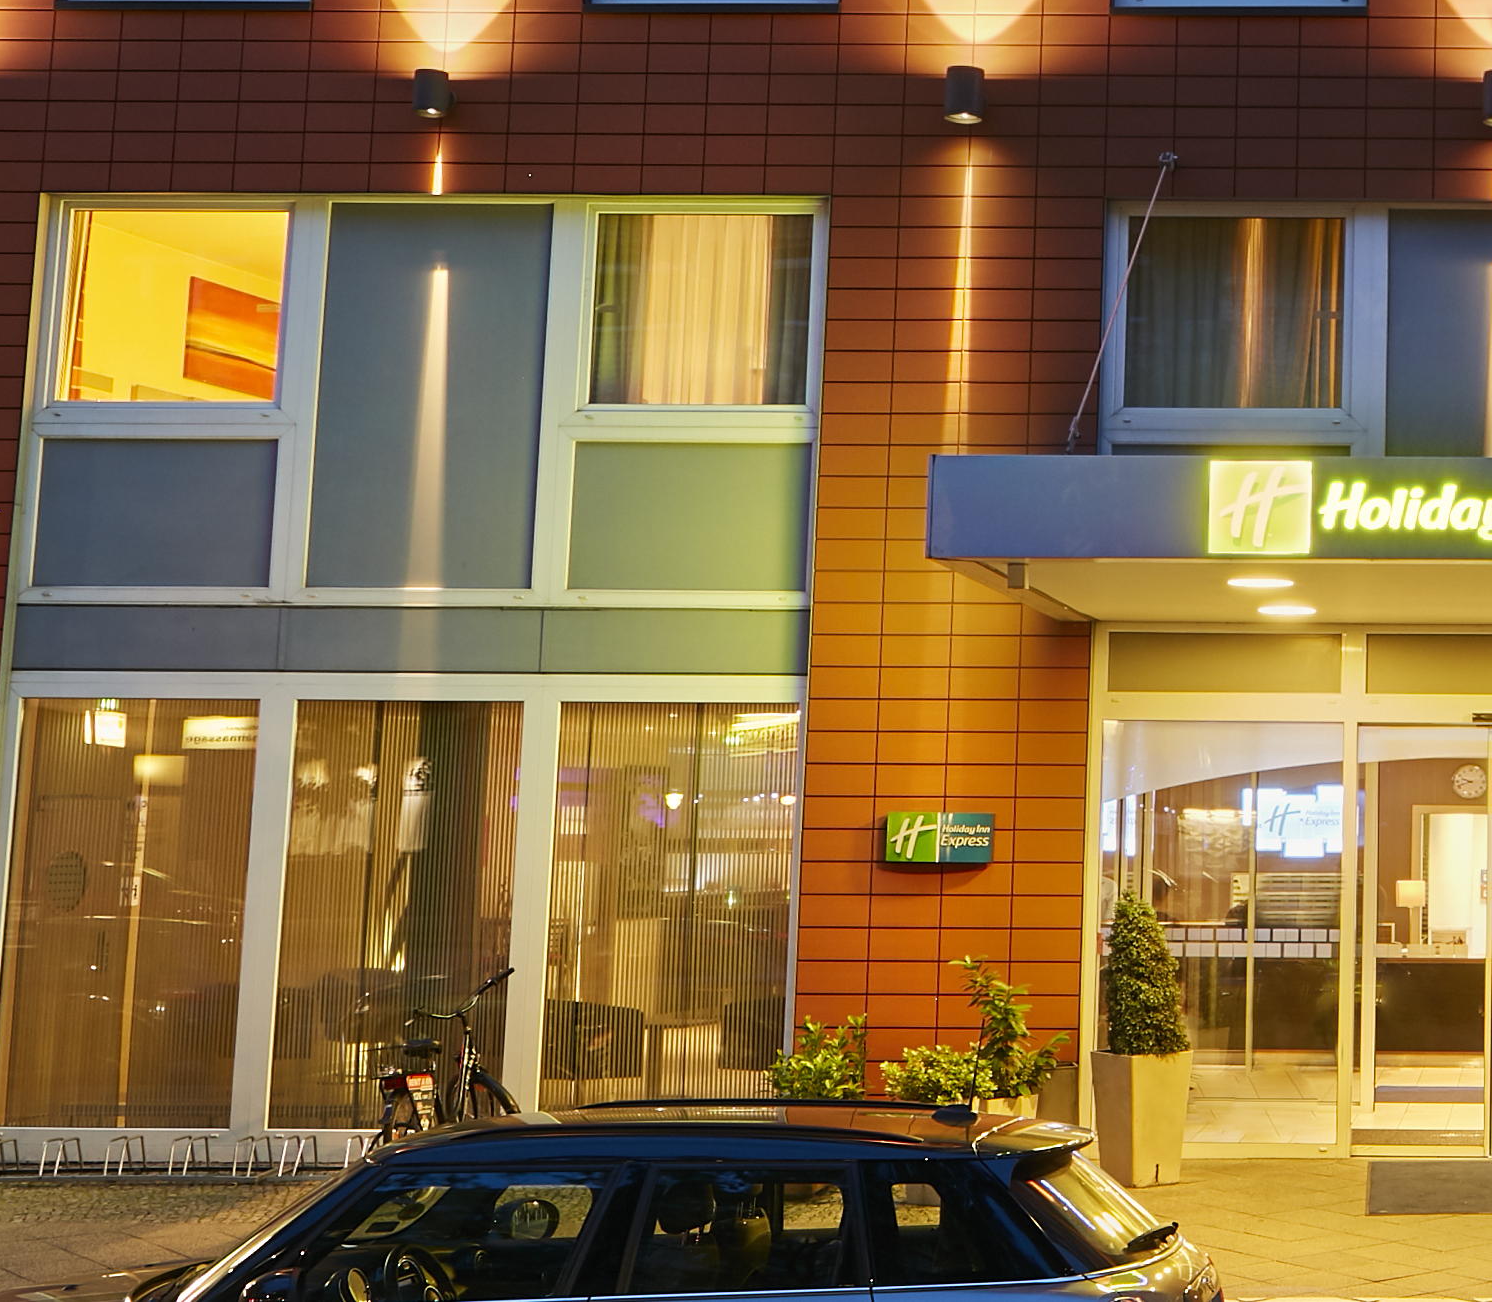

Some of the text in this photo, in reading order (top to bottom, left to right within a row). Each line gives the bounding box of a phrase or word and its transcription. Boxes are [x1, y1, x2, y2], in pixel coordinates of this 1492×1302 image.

[1305, 817, 1340, 827] Express
[941, 824, 990, 835] Holiday Inn
[941, 834, 990, 849] Express
